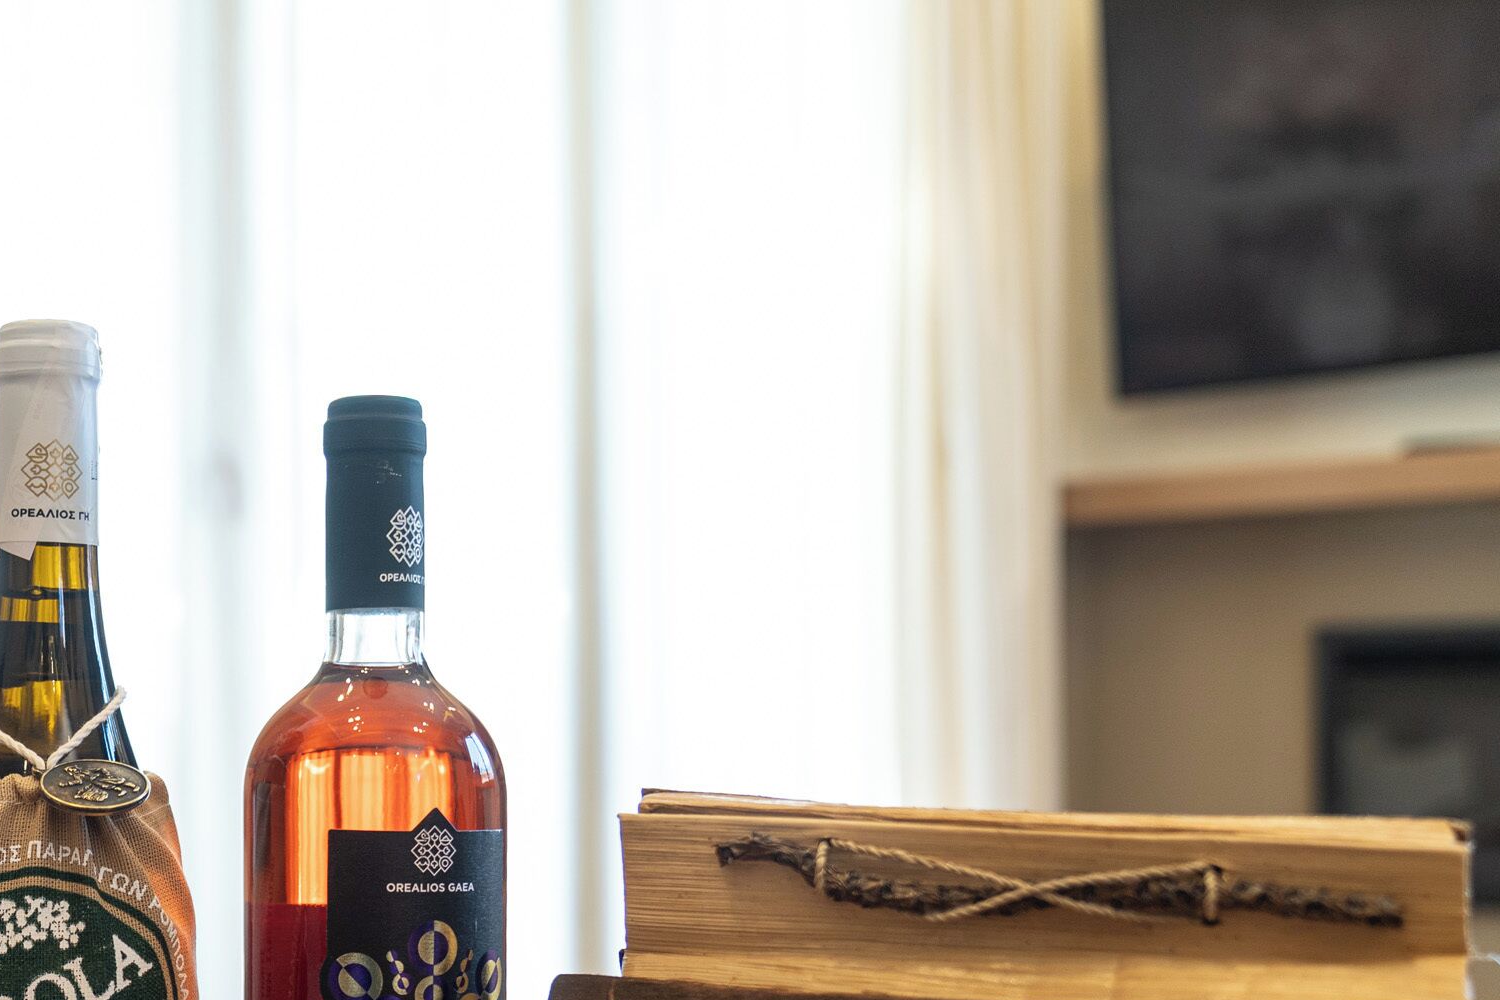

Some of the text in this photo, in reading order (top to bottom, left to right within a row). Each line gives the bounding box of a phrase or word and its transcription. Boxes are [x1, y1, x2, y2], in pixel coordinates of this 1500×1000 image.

[11, 508, 75, 520] ΟΡΕΑΛΙΟΣ
[386, 882, 475, 893] OREALIOS GAEA
